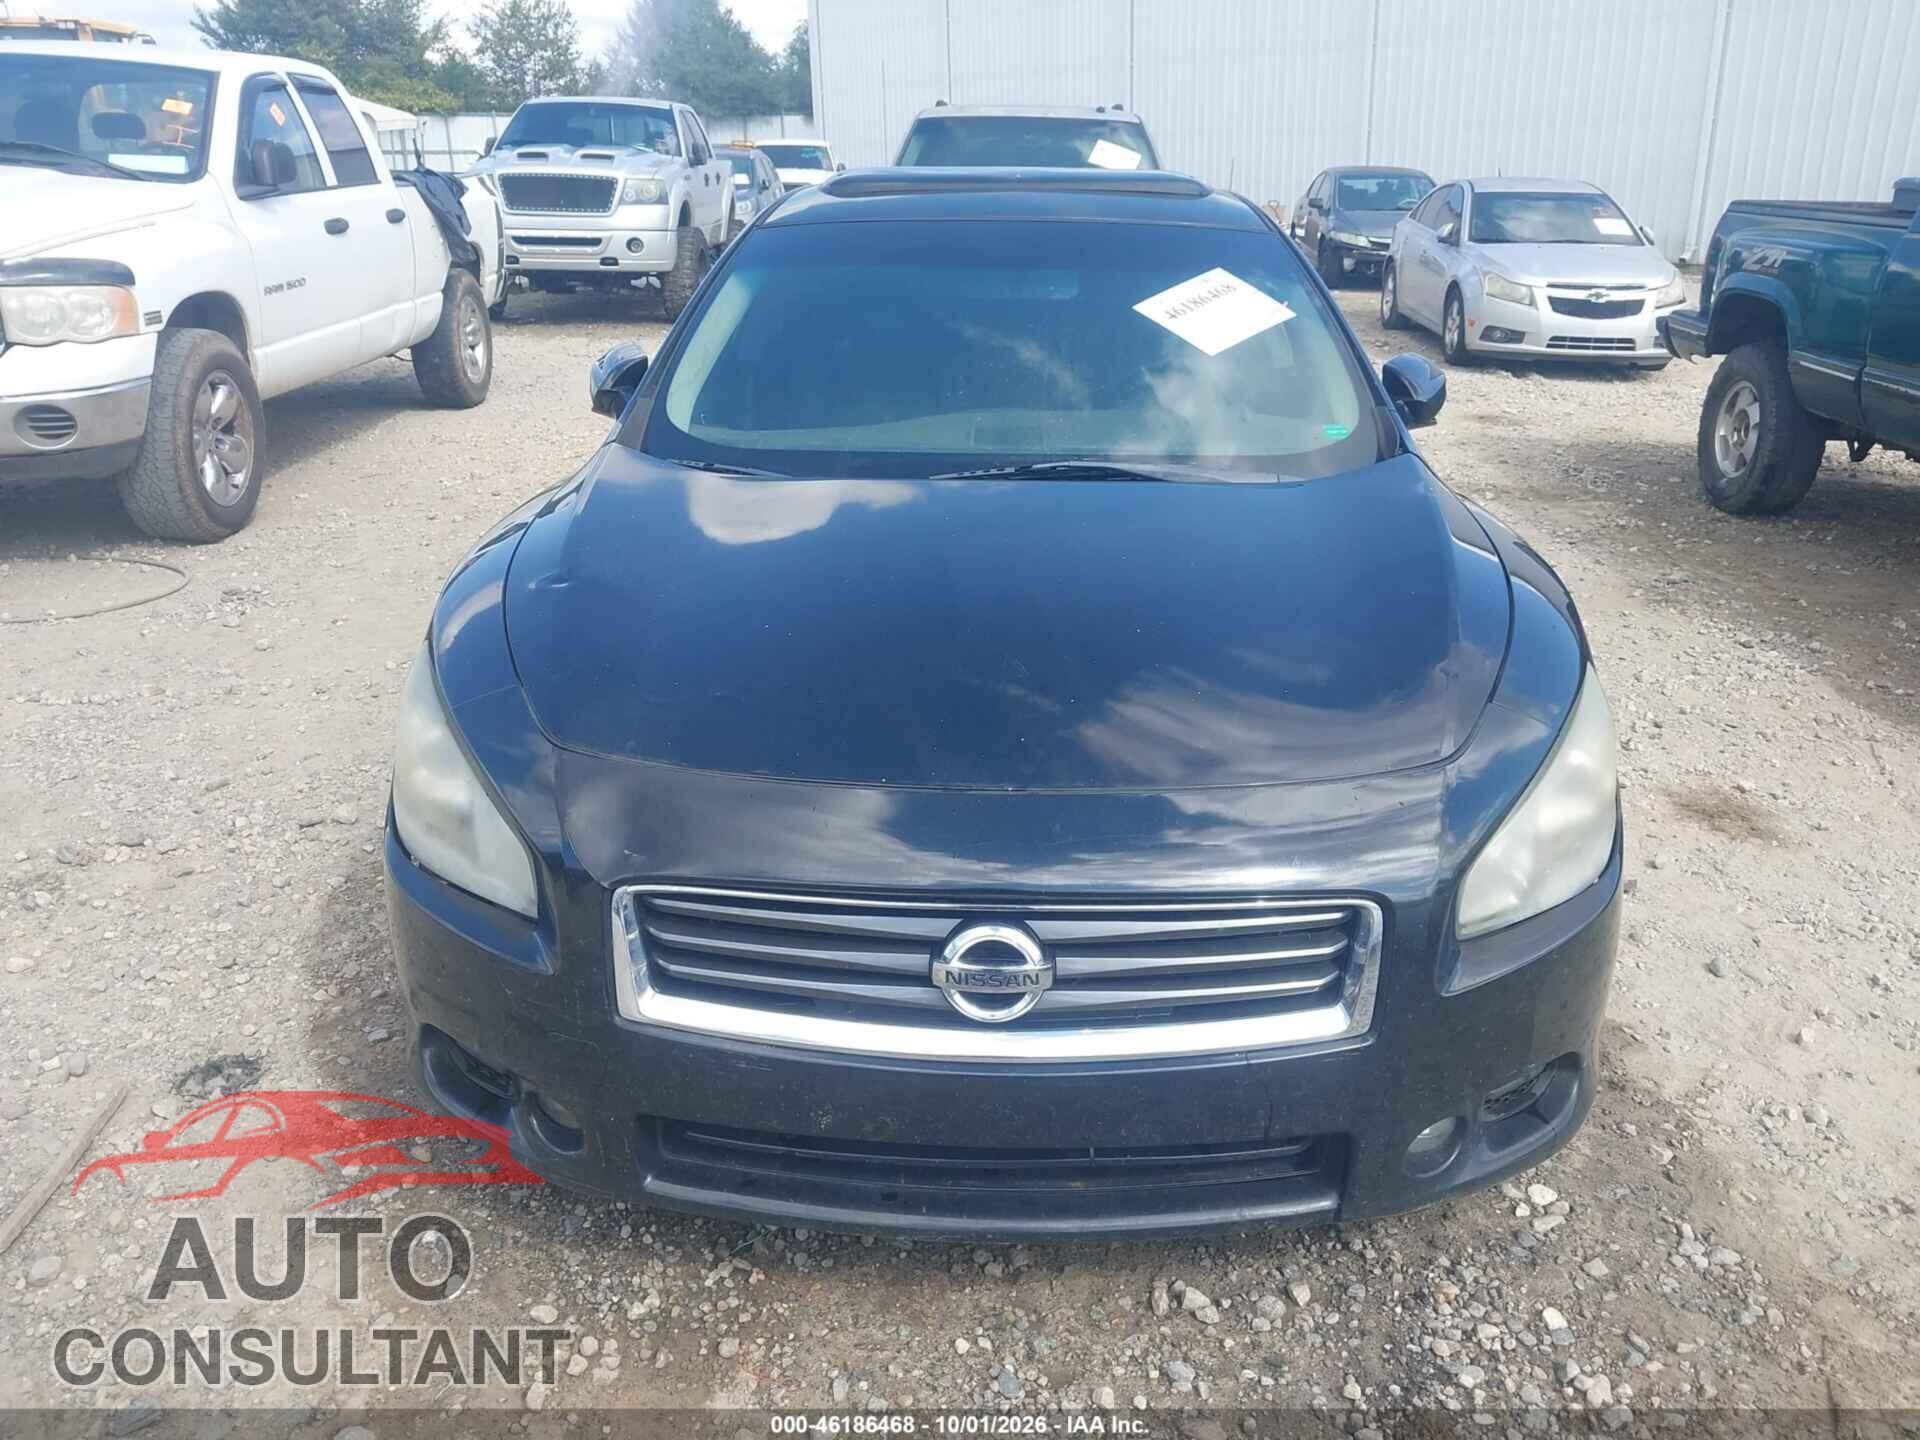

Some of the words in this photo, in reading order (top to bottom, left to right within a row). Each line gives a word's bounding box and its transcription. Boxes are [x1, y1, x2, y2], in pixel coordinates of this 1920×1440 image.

[263, 283, 285, 296] RAM
[1164, 283, 1237, 321] 46186468
[944, 970, 1041, 987] NISSAN
